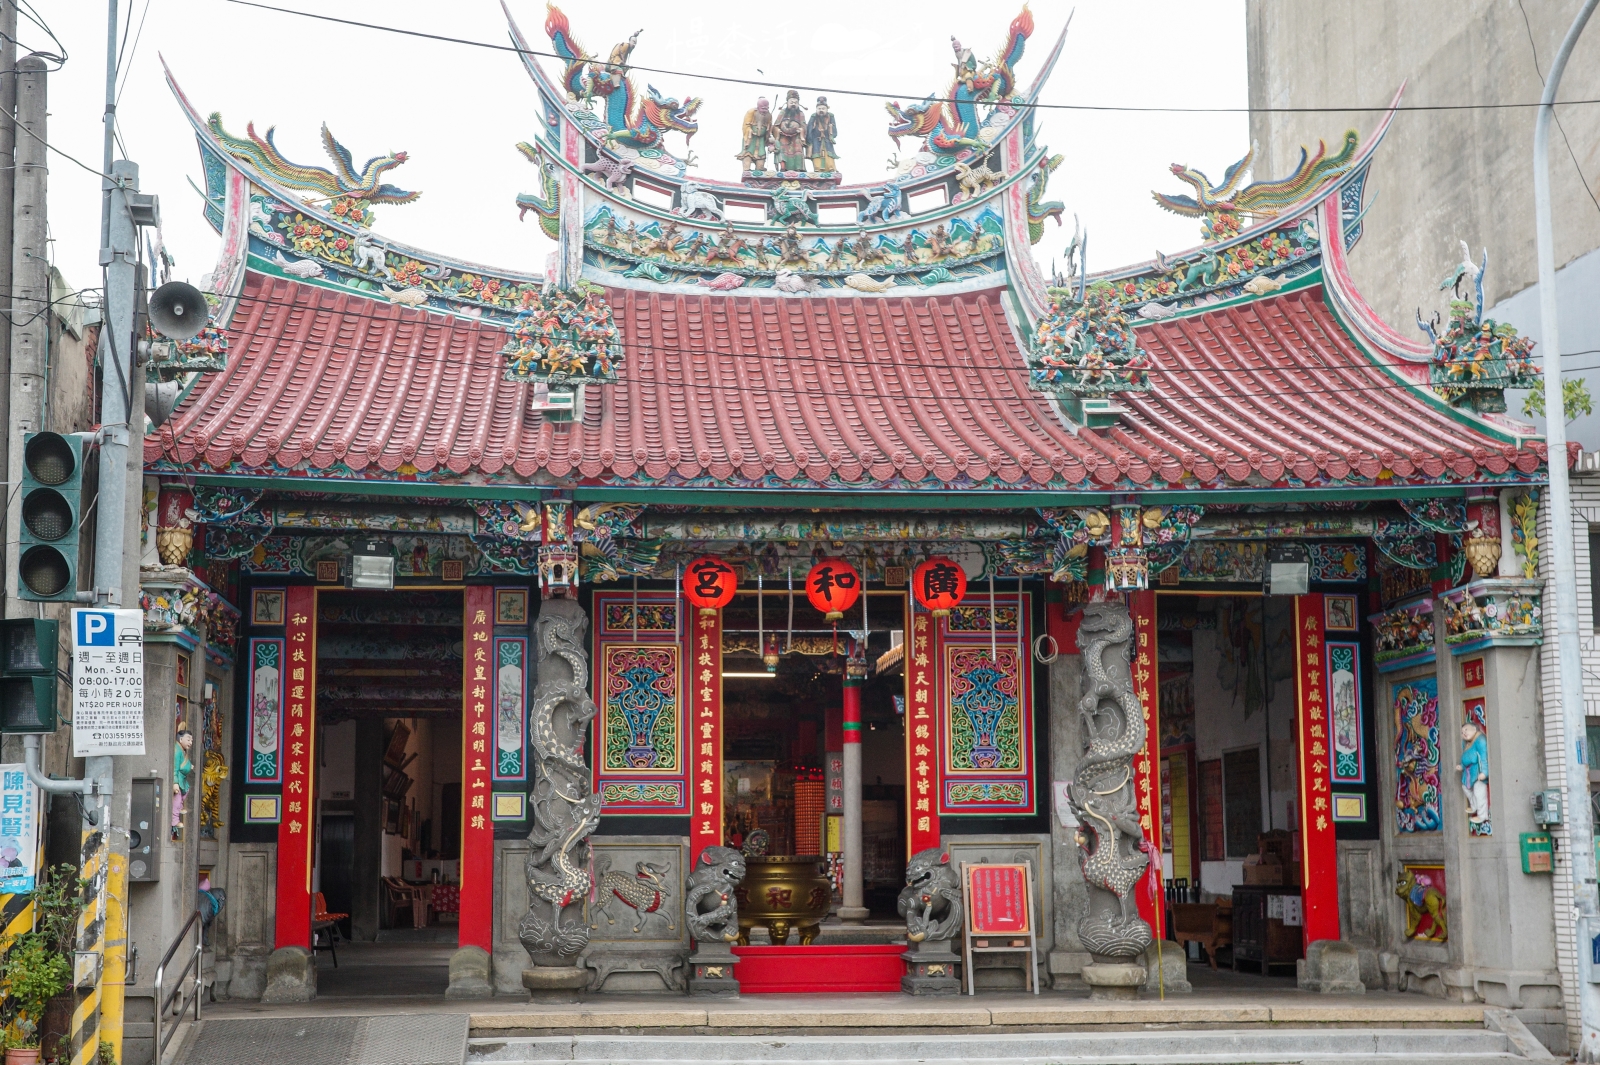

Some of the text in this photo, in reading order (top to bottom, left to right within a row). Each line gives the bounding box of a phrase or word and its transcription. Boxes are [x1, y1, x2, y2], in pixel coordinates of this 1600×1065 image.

[692, 561, 732, 598] 宮
[813, 566, 855, 602] 和
[924, 563, 959, 601] 廣
[85, 614, 107, 644] P
[78, 651, 142, 664] 週一至週日
[79, 677, 142, 686] 08:00-17:00
[830, 759, 843, 809] 許願柱
[1, 771, 24, 837] 陳見賢
